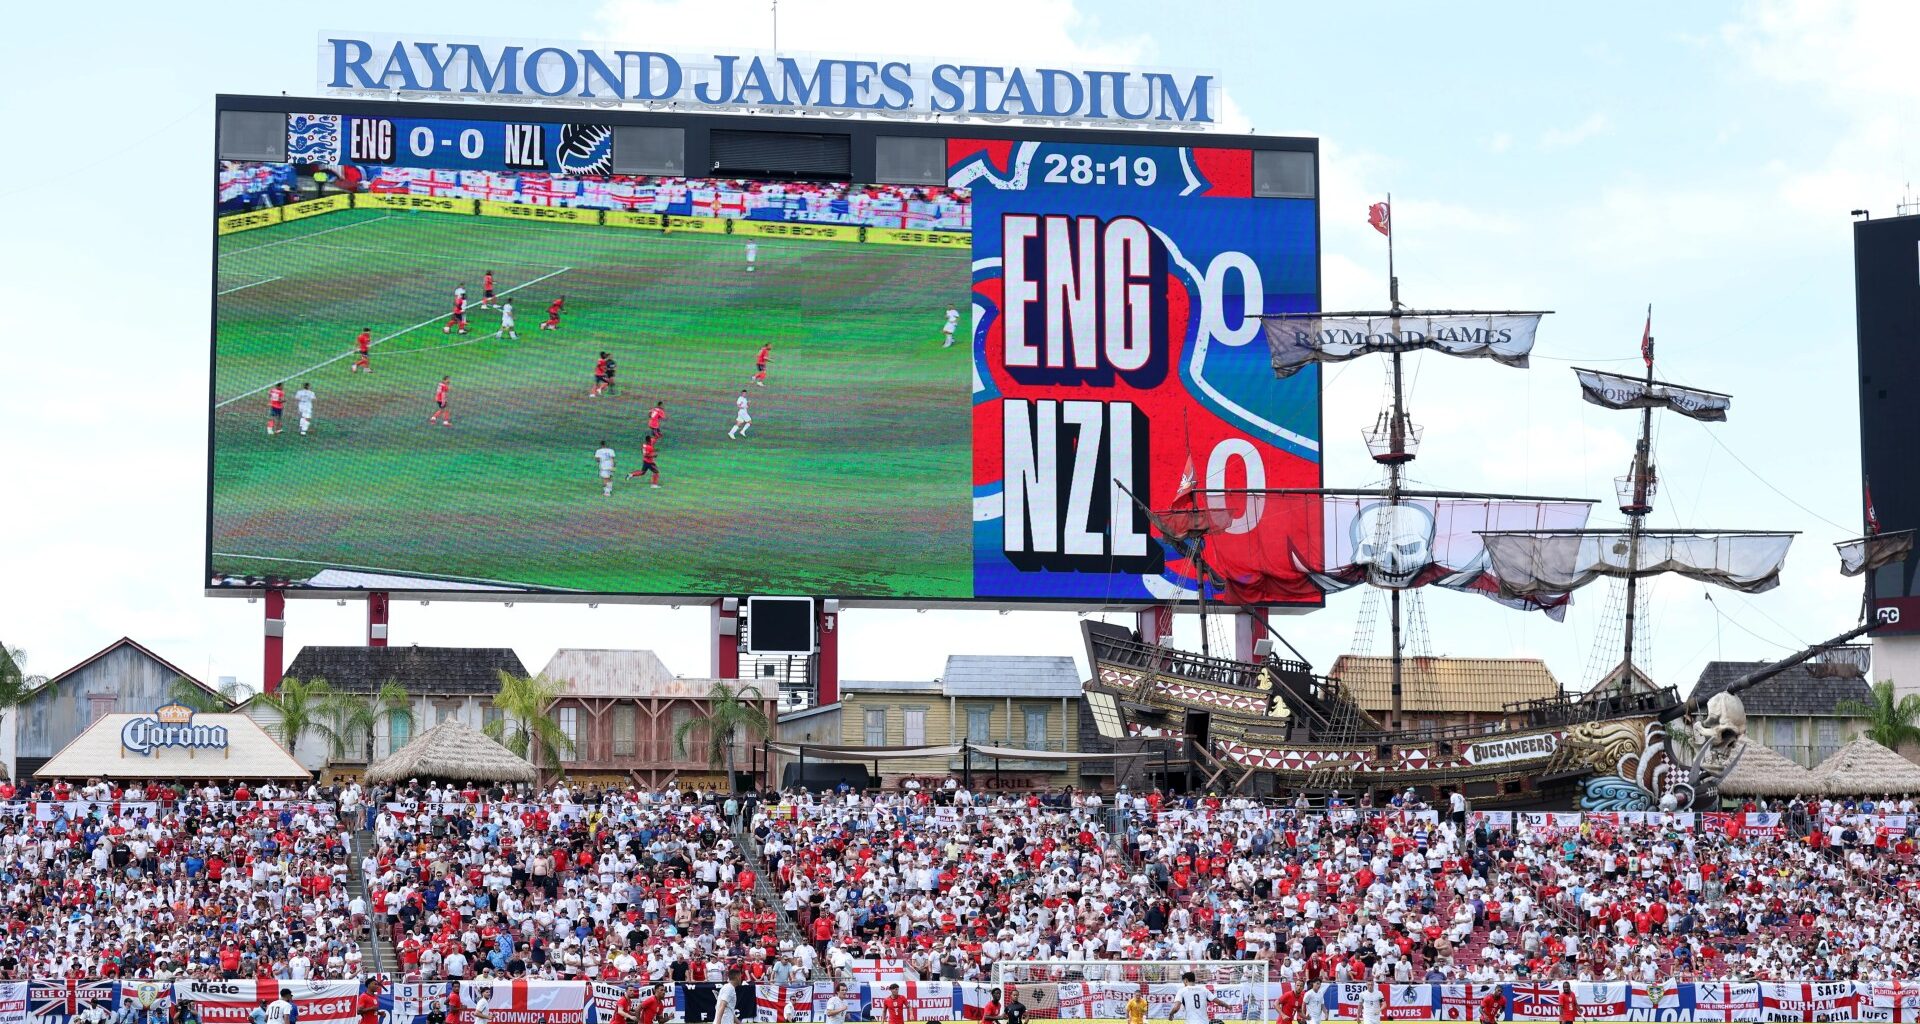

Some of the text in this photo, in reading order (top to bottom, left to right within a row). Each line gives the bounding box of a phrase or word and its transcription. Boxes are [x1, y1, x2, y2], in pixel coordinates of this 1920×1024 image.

[327, 38, 1214, 123] RAYMOND JAMES STADIUM
[350, 119, 391, 160] ENG
[505, 124, 544, 166] NZL
[1044, 153, 1157, 186] 28:19
[1003, 215, 1264, 371] ENG 0
[1295, 329, 1426, 348] RAYMOND
[1003, 399, 1266, 557] NZL 0
[122, 718, 228, 757] Corona
[1472, 734, 1553, 763] BUCCANEERS
[698, 780, 729, 789] GALLE
[986, 777, 1034, 789] GRILL
[400, 801, 444, 811] WOES
[31, 990, 112, 998] ISLE OF WIGHT
[191, 982, 239, 994] Mate
[404, 985, 437, 997] B C
[1217, 990, 1240, 998] BCFC
[1817, 983, 1845, 996] SAFC
[922, 998, 950, 1008] TOWN
[1193, 994, 1201, 1009] 8
[1780, 1000, 1835, 1010] DURHAM
[269, 1006, 280, 1019] 10
[548, 1013, 583, 1024] ALBION
[1386, 1009, 1421, 1017] ROVERS
[1767, 1012, 1798, 1023] AMBER
